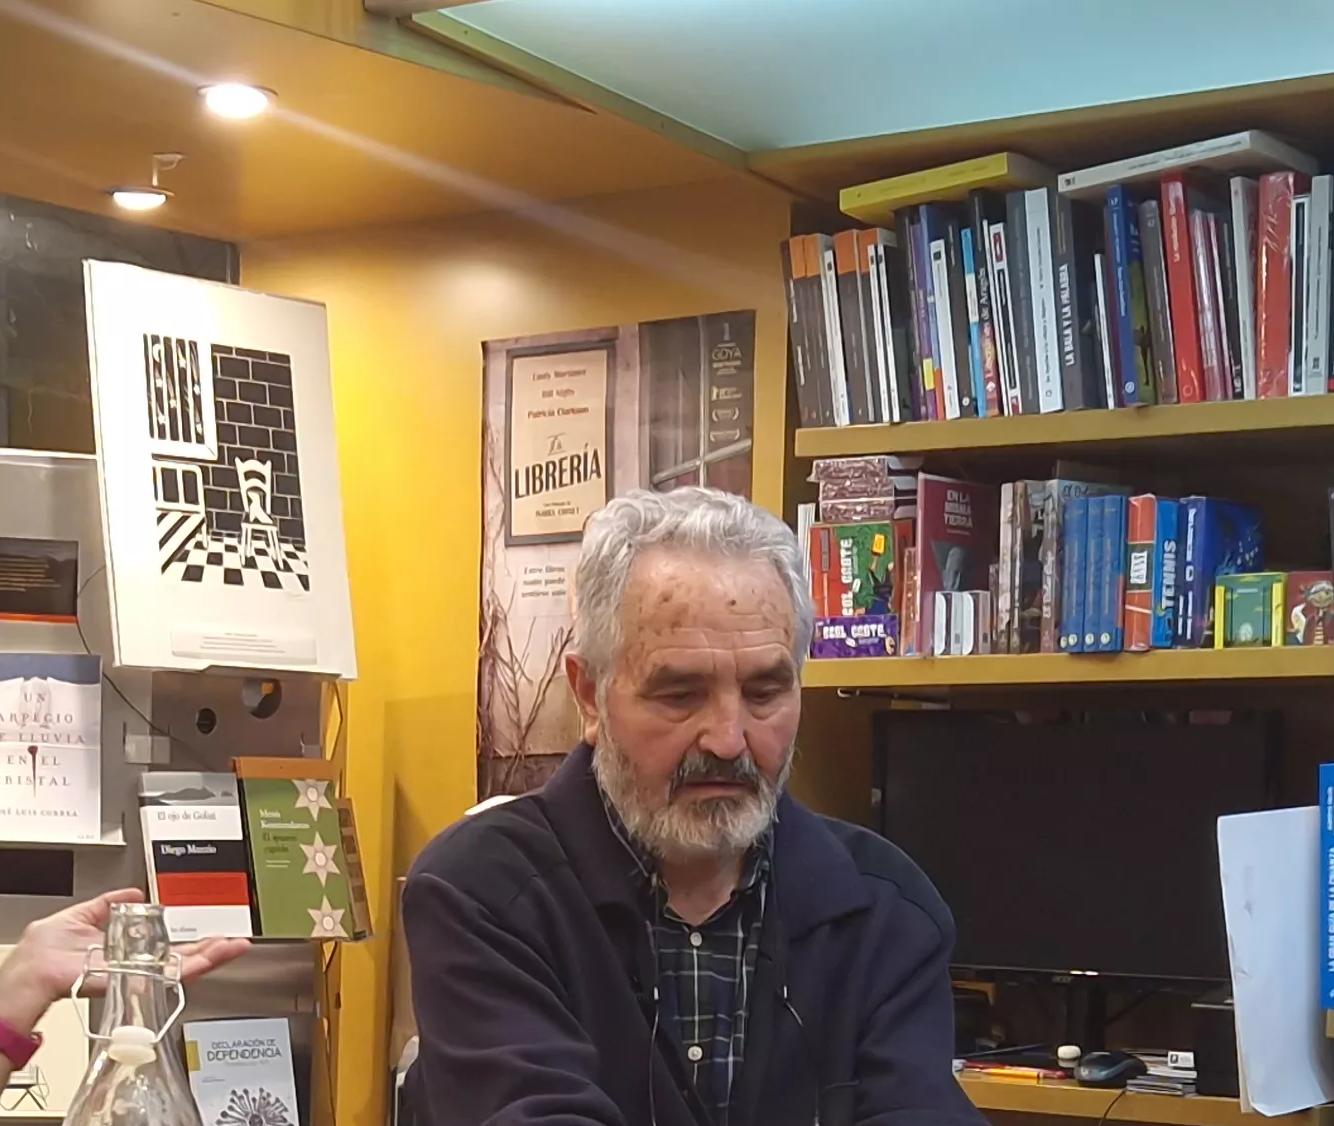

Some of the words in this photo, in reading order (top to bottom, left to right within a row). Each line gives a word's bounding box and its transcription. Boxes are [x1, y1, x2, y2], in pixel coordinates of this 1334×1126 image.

[515, 442, 601, 499] LIBRERÍA
[1161, 540, 1176, 609] TENNIS
[24, 692, 47, 703] UN
[18, 733, 86, 745] LLUVIA
[7, 755, 27, 766] EN
[41, 756, 60, 766] EL
[182, 811, 192, 820] de
